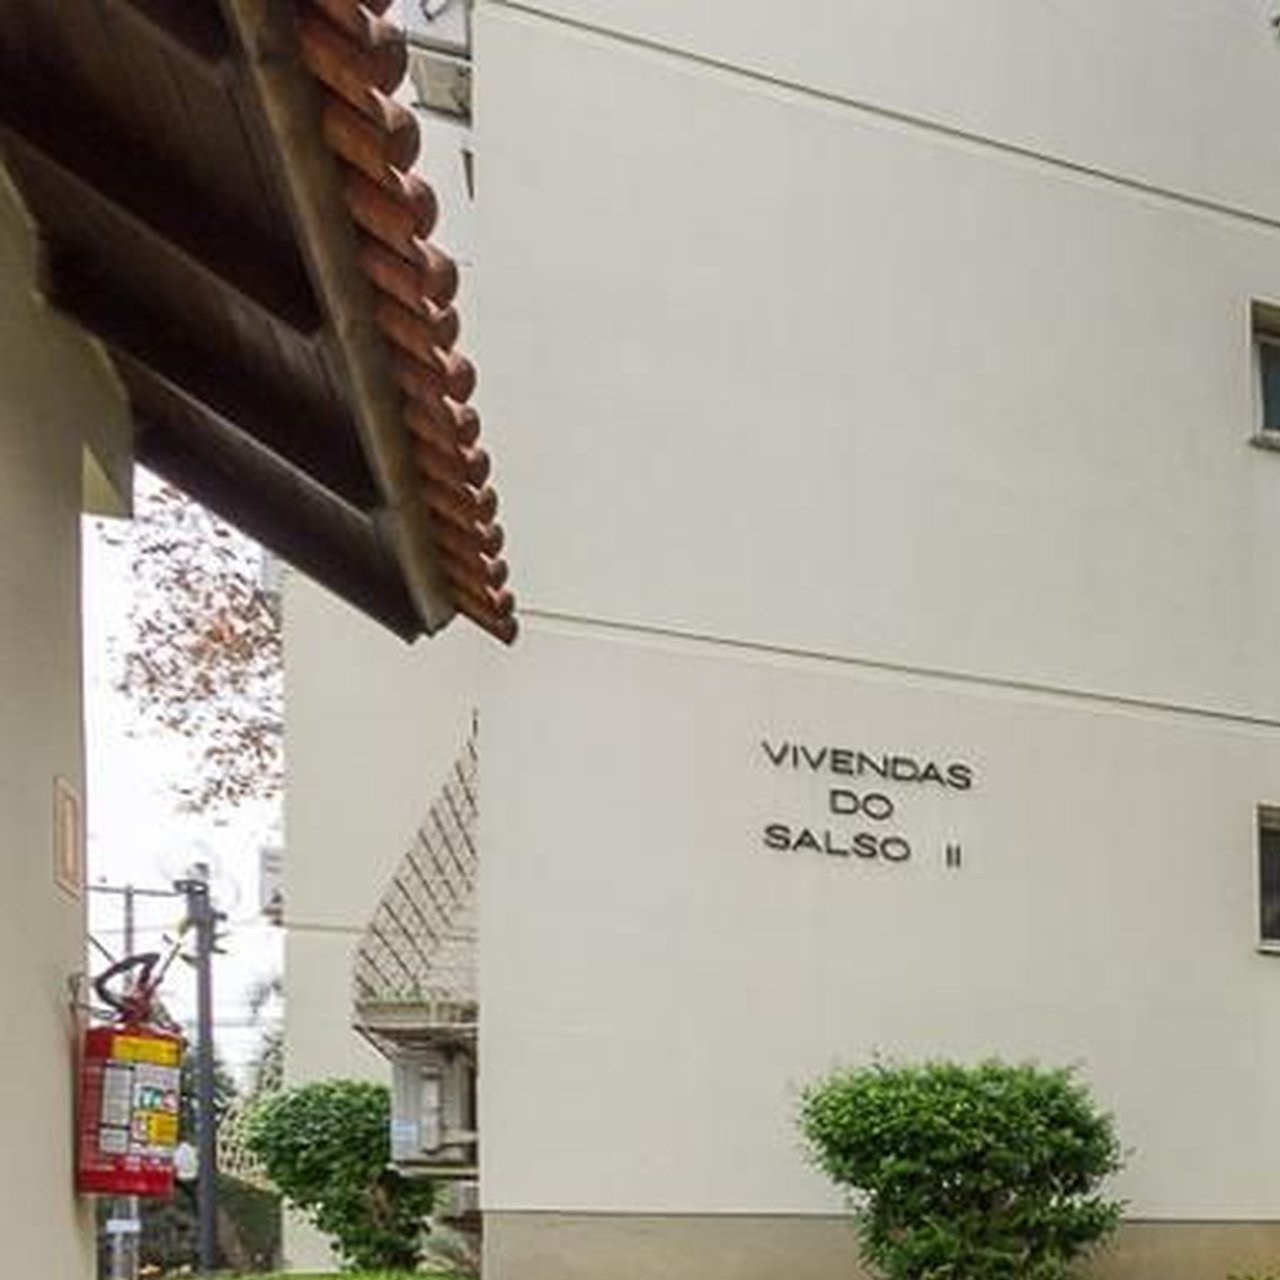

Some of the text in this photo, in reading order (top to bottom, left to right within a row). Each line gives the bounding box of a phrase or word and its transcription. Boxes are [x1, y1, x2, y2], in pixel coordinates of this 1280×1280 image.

[761, 740, 973, 790] VIVENDAS
[829, 789, 894, 820] DO
[763, 823, 961, 869] SALSO II
